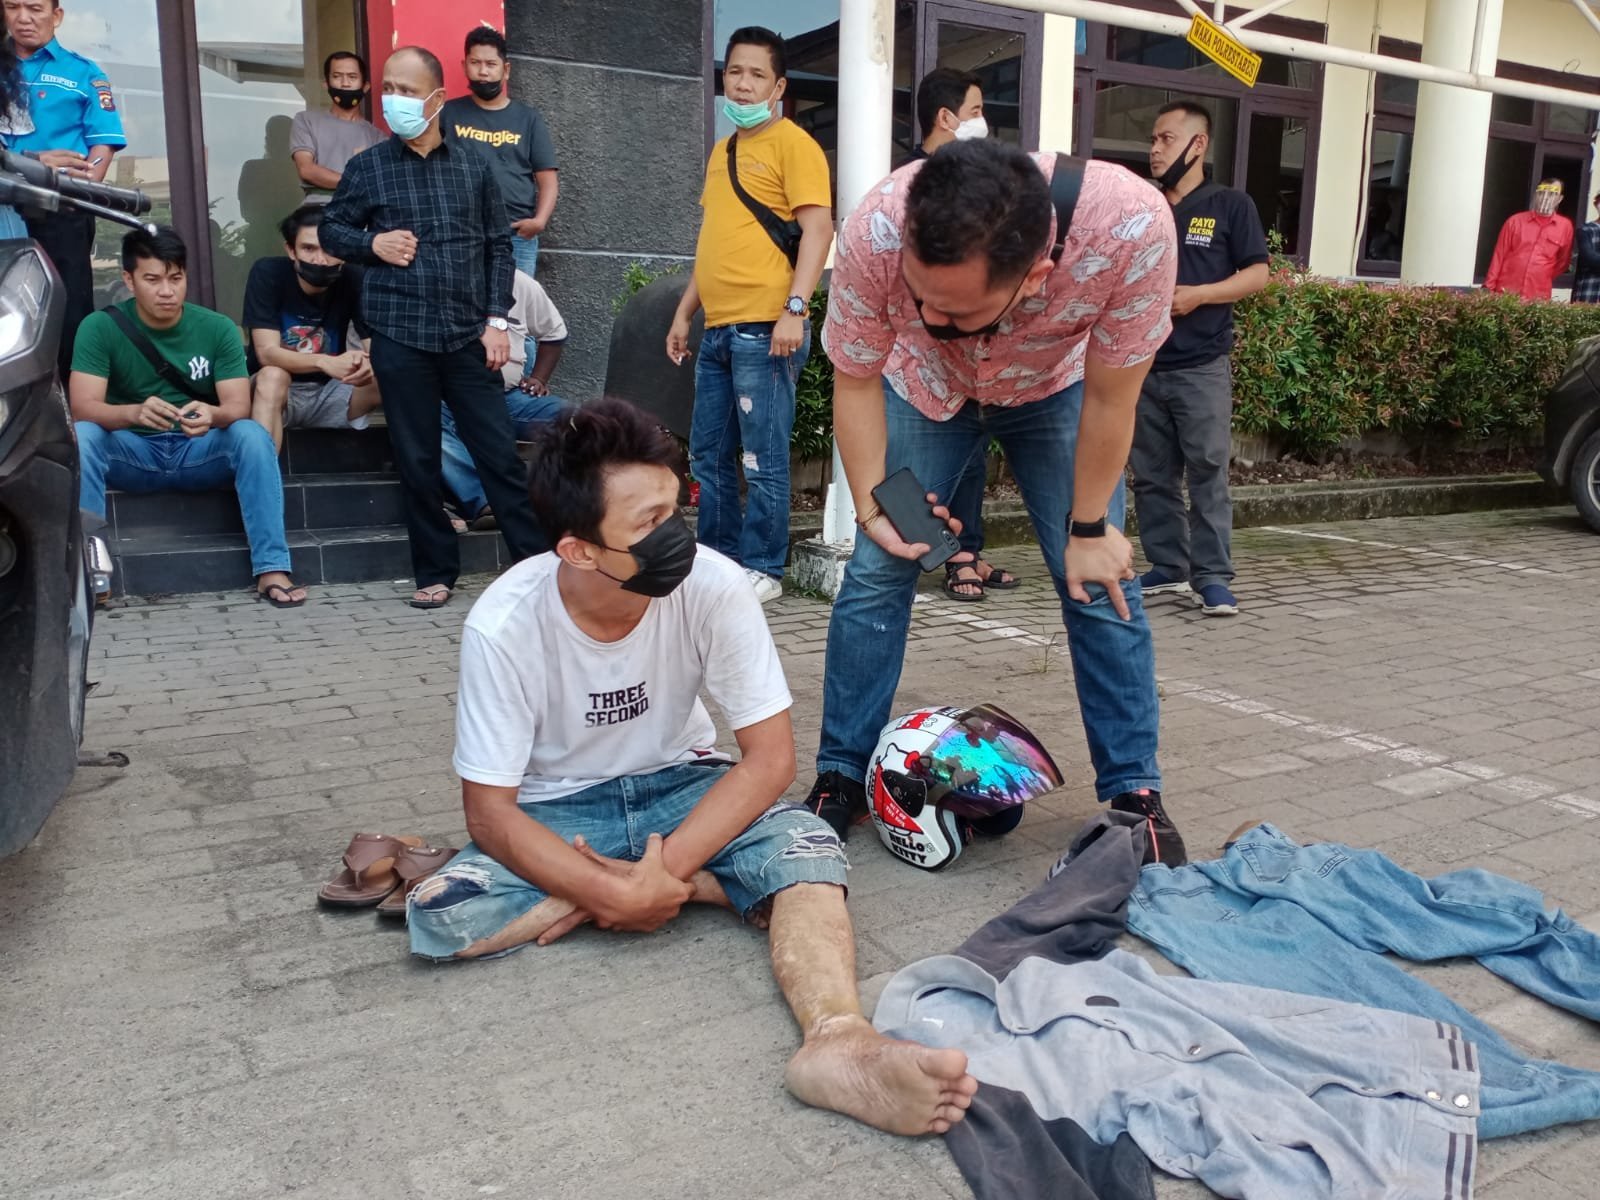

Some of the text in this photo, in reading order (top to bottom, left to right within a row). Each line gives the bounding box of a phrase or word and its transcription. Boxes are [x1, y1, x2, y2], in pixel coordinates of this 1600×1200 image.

[1194, 20, 1256, 77] WAKA POLRESTABES
[455, 124, 522, 147] Wrangler
[1190, 217, 1216, 228] PAYO
[588, 681, 646, 709] THREE
[585, 697, 649, 728] SECOND
[889, 832, 926, 852] HELLO
[891, 843, 928, 864] KITTY
